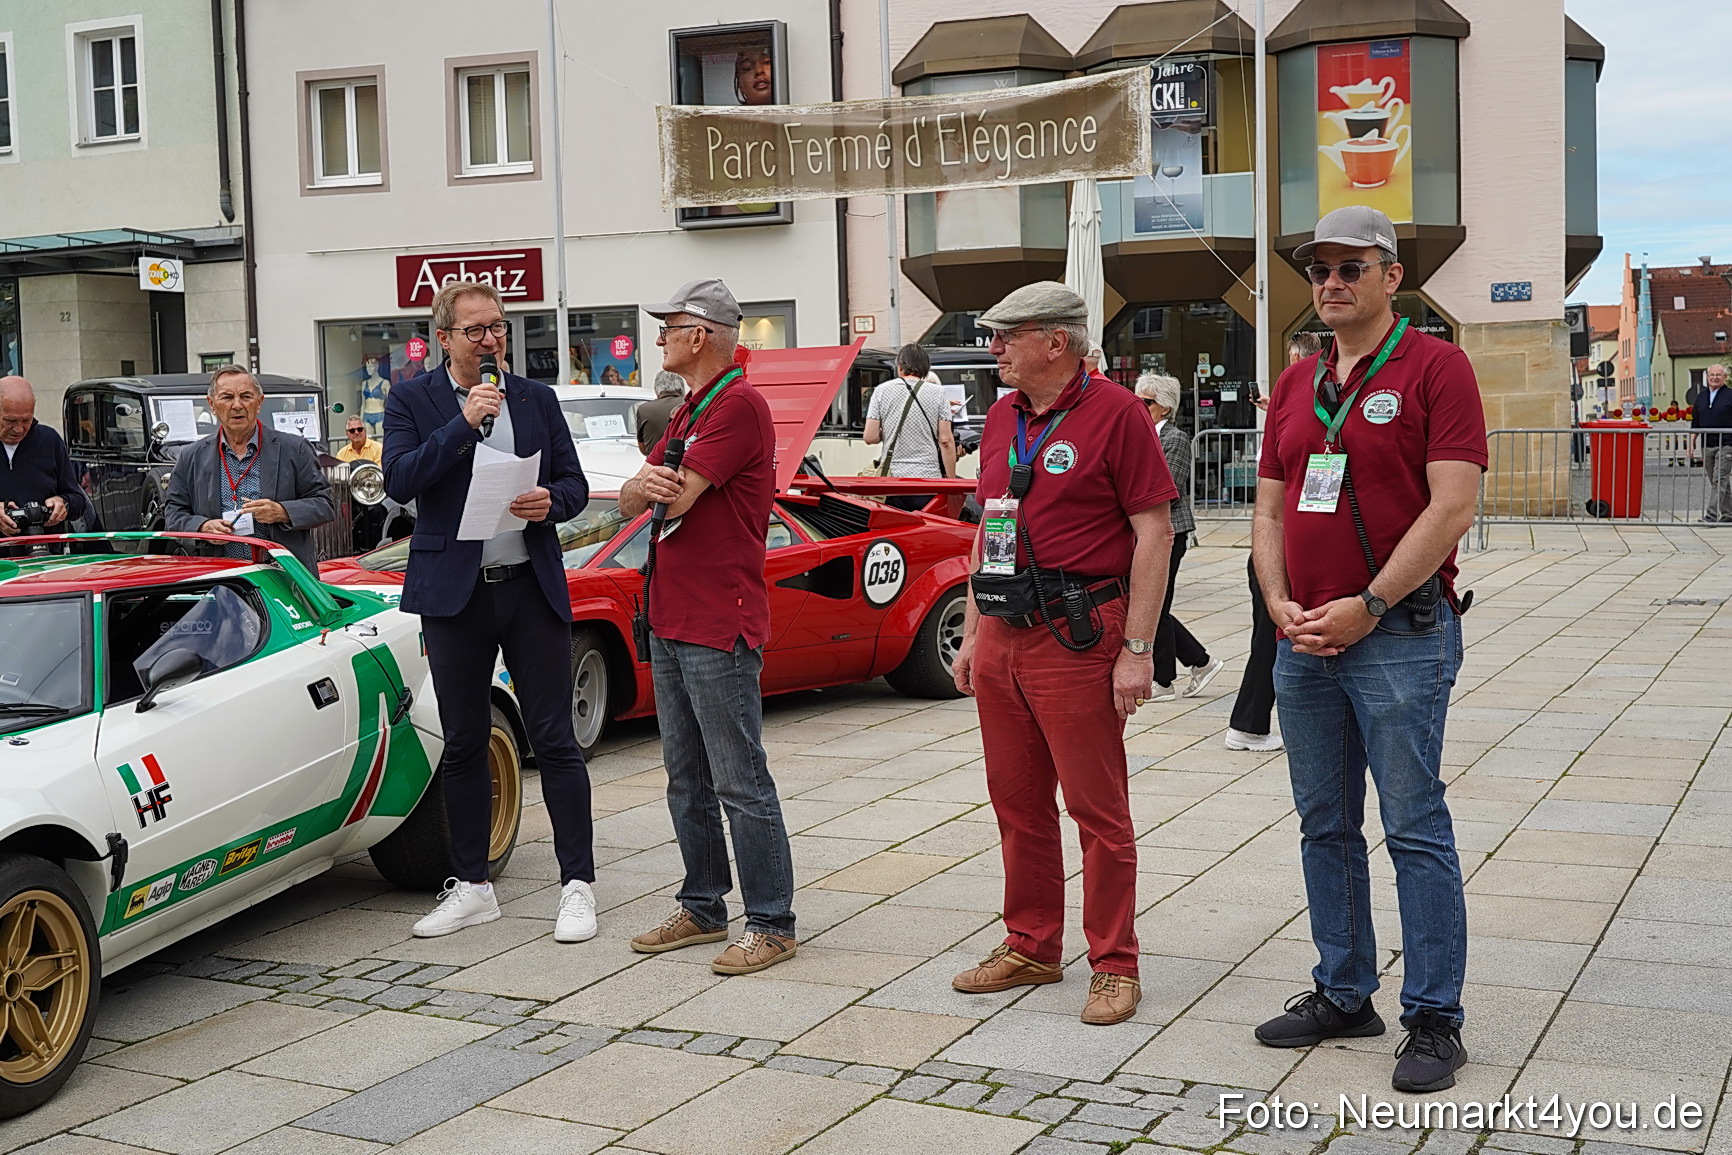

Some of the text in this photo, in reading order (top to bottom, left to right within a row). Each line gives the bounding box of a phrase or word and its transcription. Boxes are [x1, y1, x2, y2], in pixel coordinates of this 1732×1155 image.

[1156, 63, 1194, 80] Jahre
[1151, 82, 1185, 110] CKL
[706, 126, 776, 181] Parc
[783, 119, 891, 177] Fermé
[409, 259, 527, 301] Achatz
[60, 311, 71, 322] 22
[294, 417, 308, 425] 447
[867, 559, 900, 587] 038
[130, 781, 172, 830] HF
[224, 844, 259, 867] Britax
[148, 880, 172, 901] Agip
